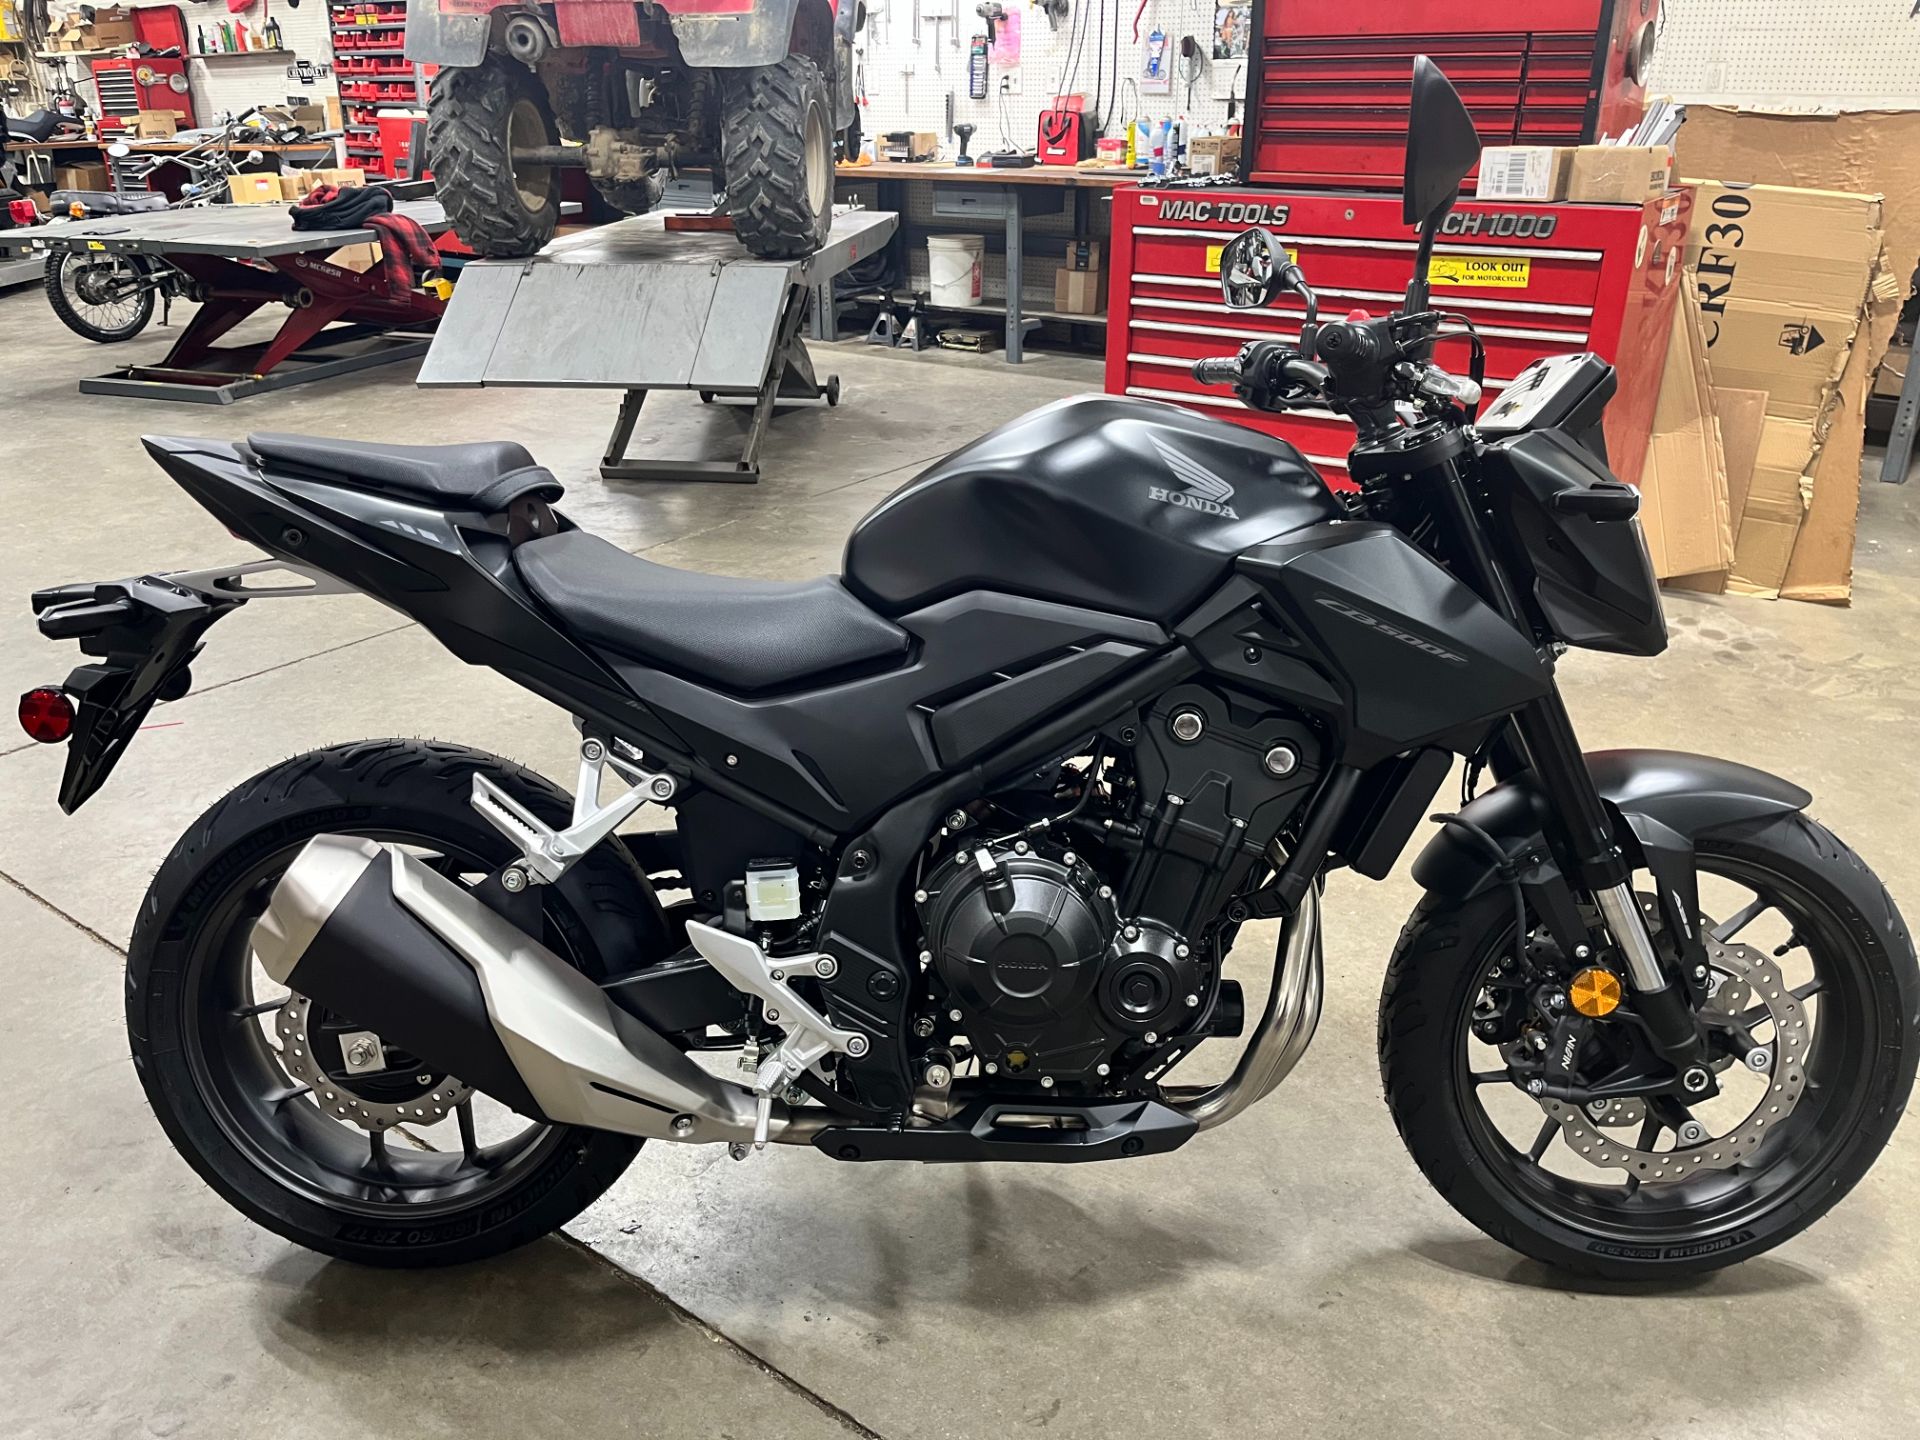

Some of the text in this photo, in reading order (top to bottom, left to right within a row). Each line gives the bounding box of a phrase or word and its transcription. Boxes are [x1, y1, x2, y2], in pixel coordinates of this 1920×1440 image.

[288, 67, 326, 78] CHEVROLET
[1158, 200, 1290, 226] MAC TOOLS
[1489, 213, 1557, 238] 1000
[1466, 262, 1525, 272] LOOK OUT
[1148, 485, 1239, 519] HONDA
[1668, 1238, 1731, 1258] MICHELIN
